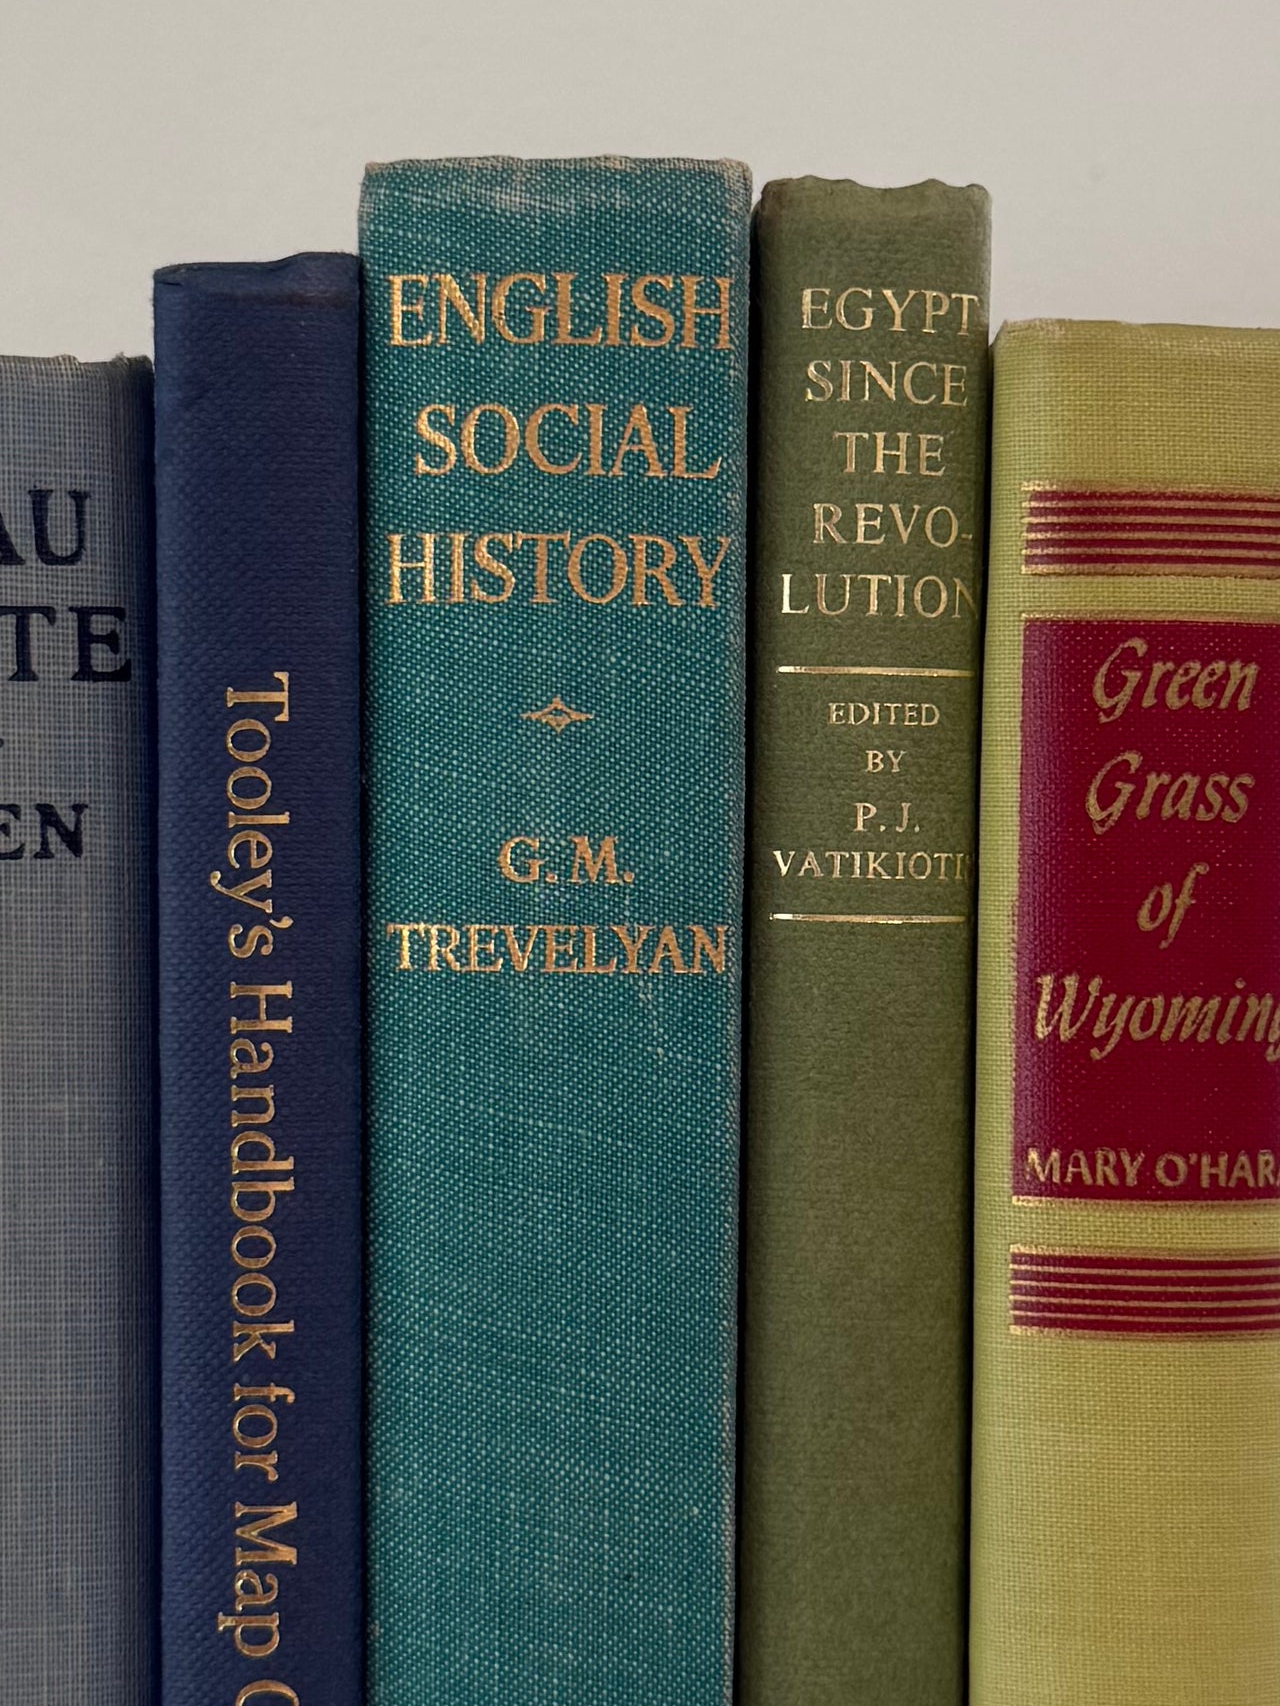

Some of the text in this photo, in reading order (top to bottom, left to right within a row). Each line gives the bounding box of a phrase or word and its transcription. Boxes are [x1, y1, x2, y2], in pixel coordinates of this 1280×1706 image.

[385, 272, 734, 350] ENGLISH
[801, 287, 980, 335] EGYPT
[805, 360, 968, 407] SINCE
[413, 402, 722, 480] SOCIAL
[833, 431, 946, 477] THE
[812, 502, 974, 549] REVO-
[385, 530, 732, 608] HISTORY
[827, 702, 941, 727] EDITED
[1091, 637, 1260, 724] Green
[864, 750, 906, 774] BY
[1085, 749, 1257, 835] Grass
[210, 671, 294, 960] Tooley's
[1136, 862, 1210, 950] of
[386, 922, 730, 975] TREVELYAN
[228, 981, 295, 1362] Handbook
[1026, 1147, 1146, 1188] MARY
[232, 1381, 296, 1483] for
[217, 1500, 299, 1659] Map
